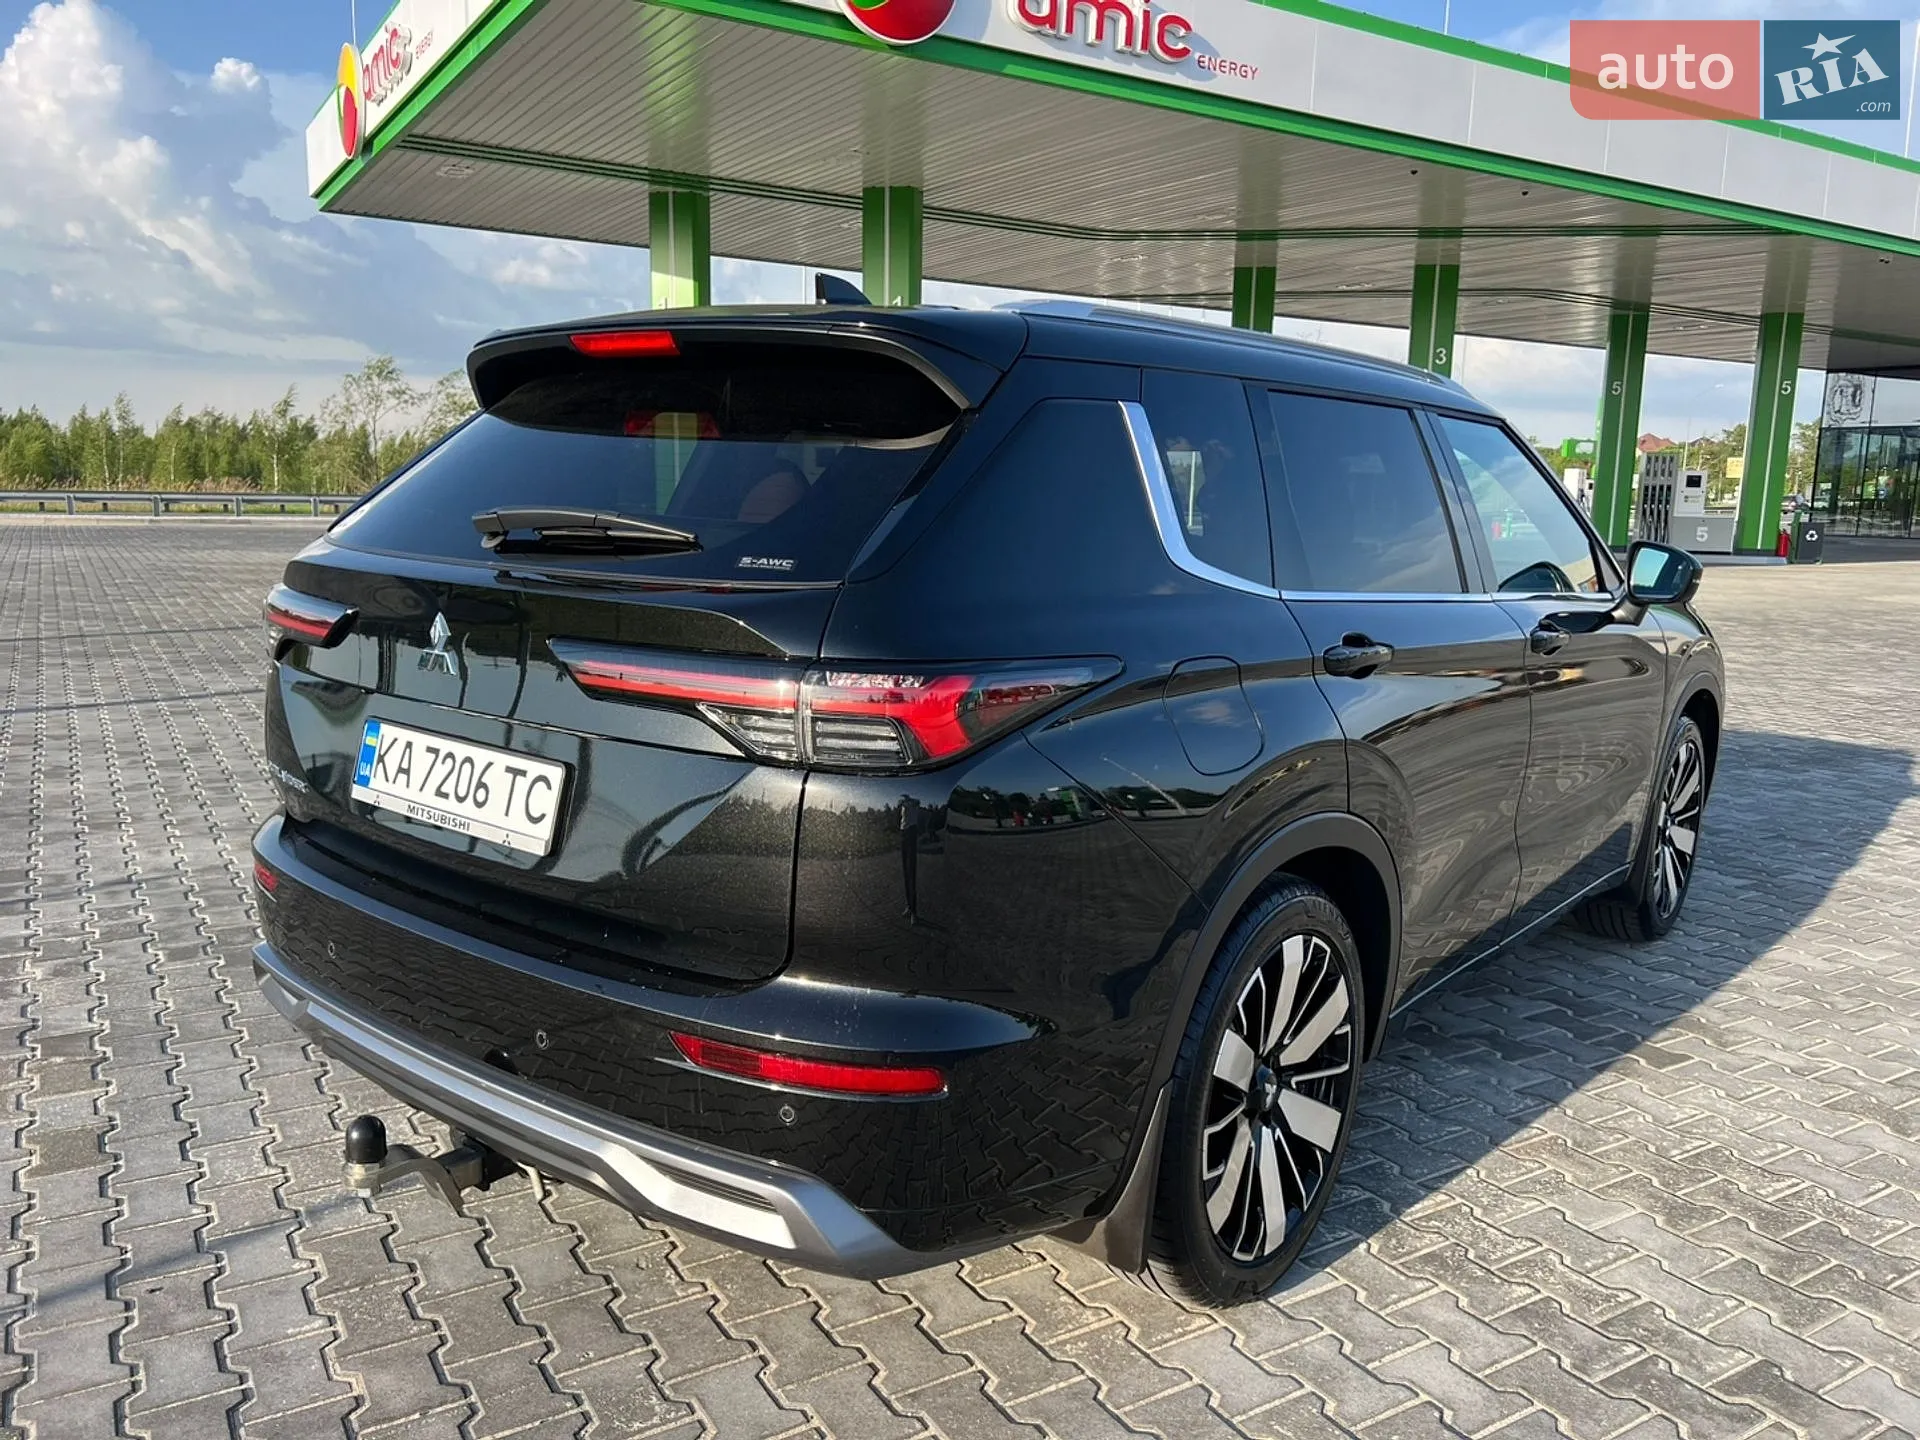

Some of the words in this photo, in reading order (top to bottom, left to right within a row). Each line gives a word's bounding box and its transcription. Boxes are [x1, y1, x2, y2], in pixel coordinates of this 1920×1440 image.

[1010, 0, 1194, 62] amic
[1197, 54, 1259, 79] ENERGY
[1435, 348, 1447, 365] 3
[1611, 380, 1622, 396] 5
[1781, 380, 1792, 396] 5
[1696, 526, 1708, 543] 5
[740, 557, 794, 567] S-AWC
[374, 734, 413, 789] KA
[419, 748, 495, 810] 7206
[504, 766, 553, 825] TC
[406, 804, 471, 833] MITSUBISHI
